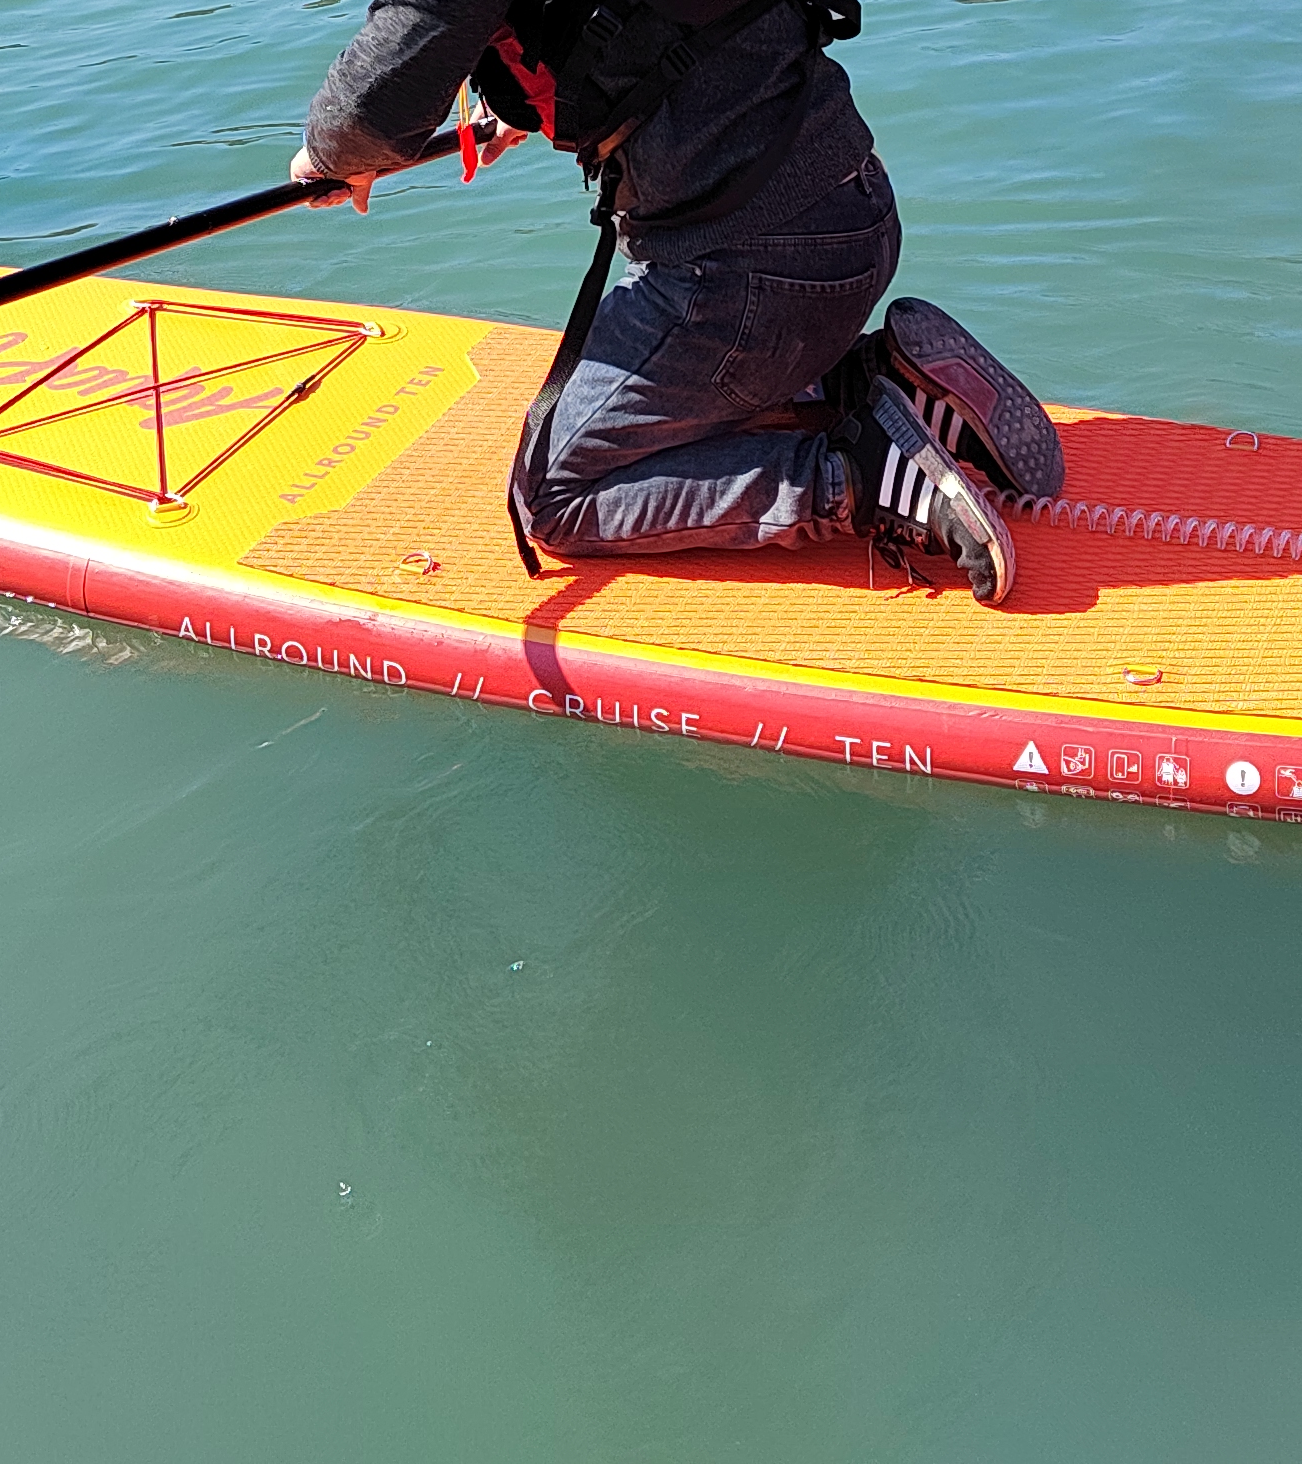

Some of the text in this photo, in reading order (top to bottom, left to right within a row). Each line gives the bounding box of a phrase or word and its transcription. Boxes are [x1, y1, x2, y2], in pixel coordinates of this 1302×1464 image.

[278, 365, 445, 505] ALLROUND TEN
[178, 616, 407, 686] ALLROUND
[527, 688, 701, 738] CRUISE
[834, 735, 933, 775] TEN
